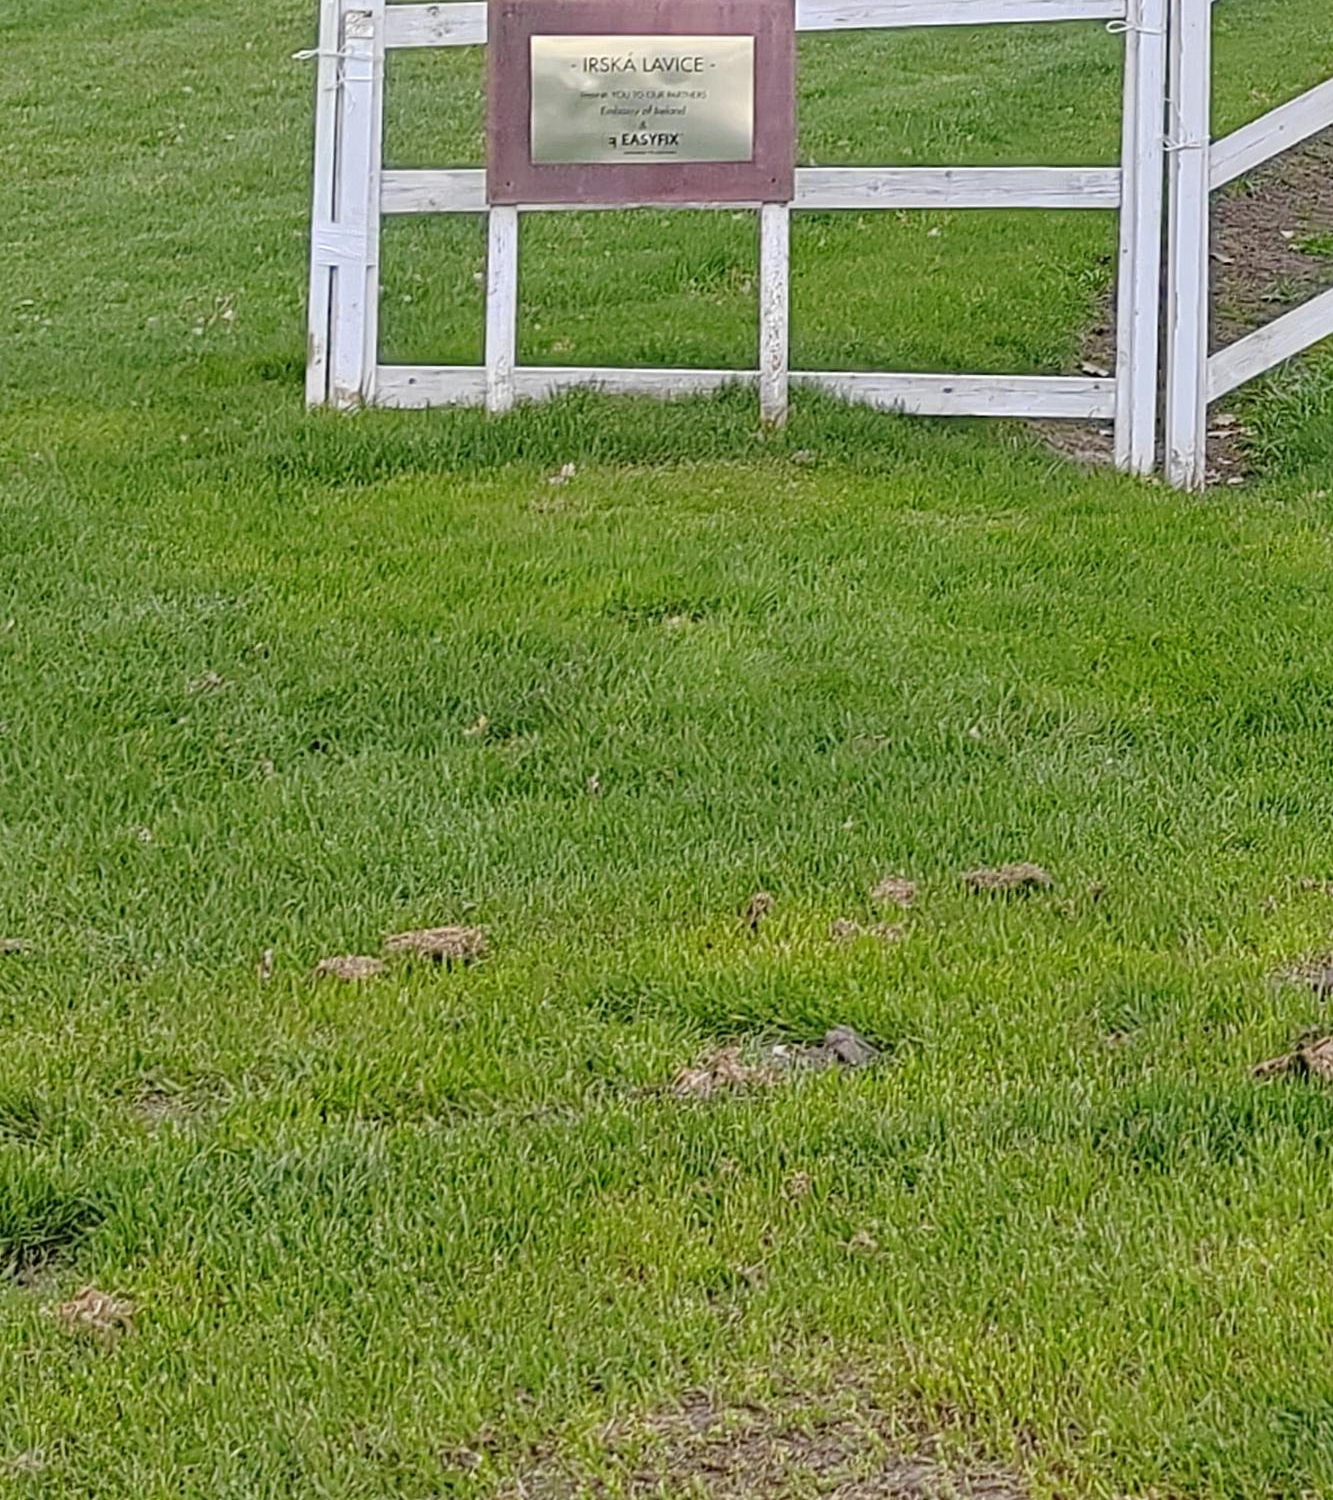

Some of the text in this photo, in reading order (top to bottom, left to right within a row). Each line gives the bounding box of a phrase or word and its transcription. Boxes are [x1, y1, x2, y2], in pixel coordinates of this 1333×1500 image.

[583, 52, 636, 73] IRSKÁ
[643, 56, 704, 73] LAVICE
[621, 133, 679, 146] EASYFIX
